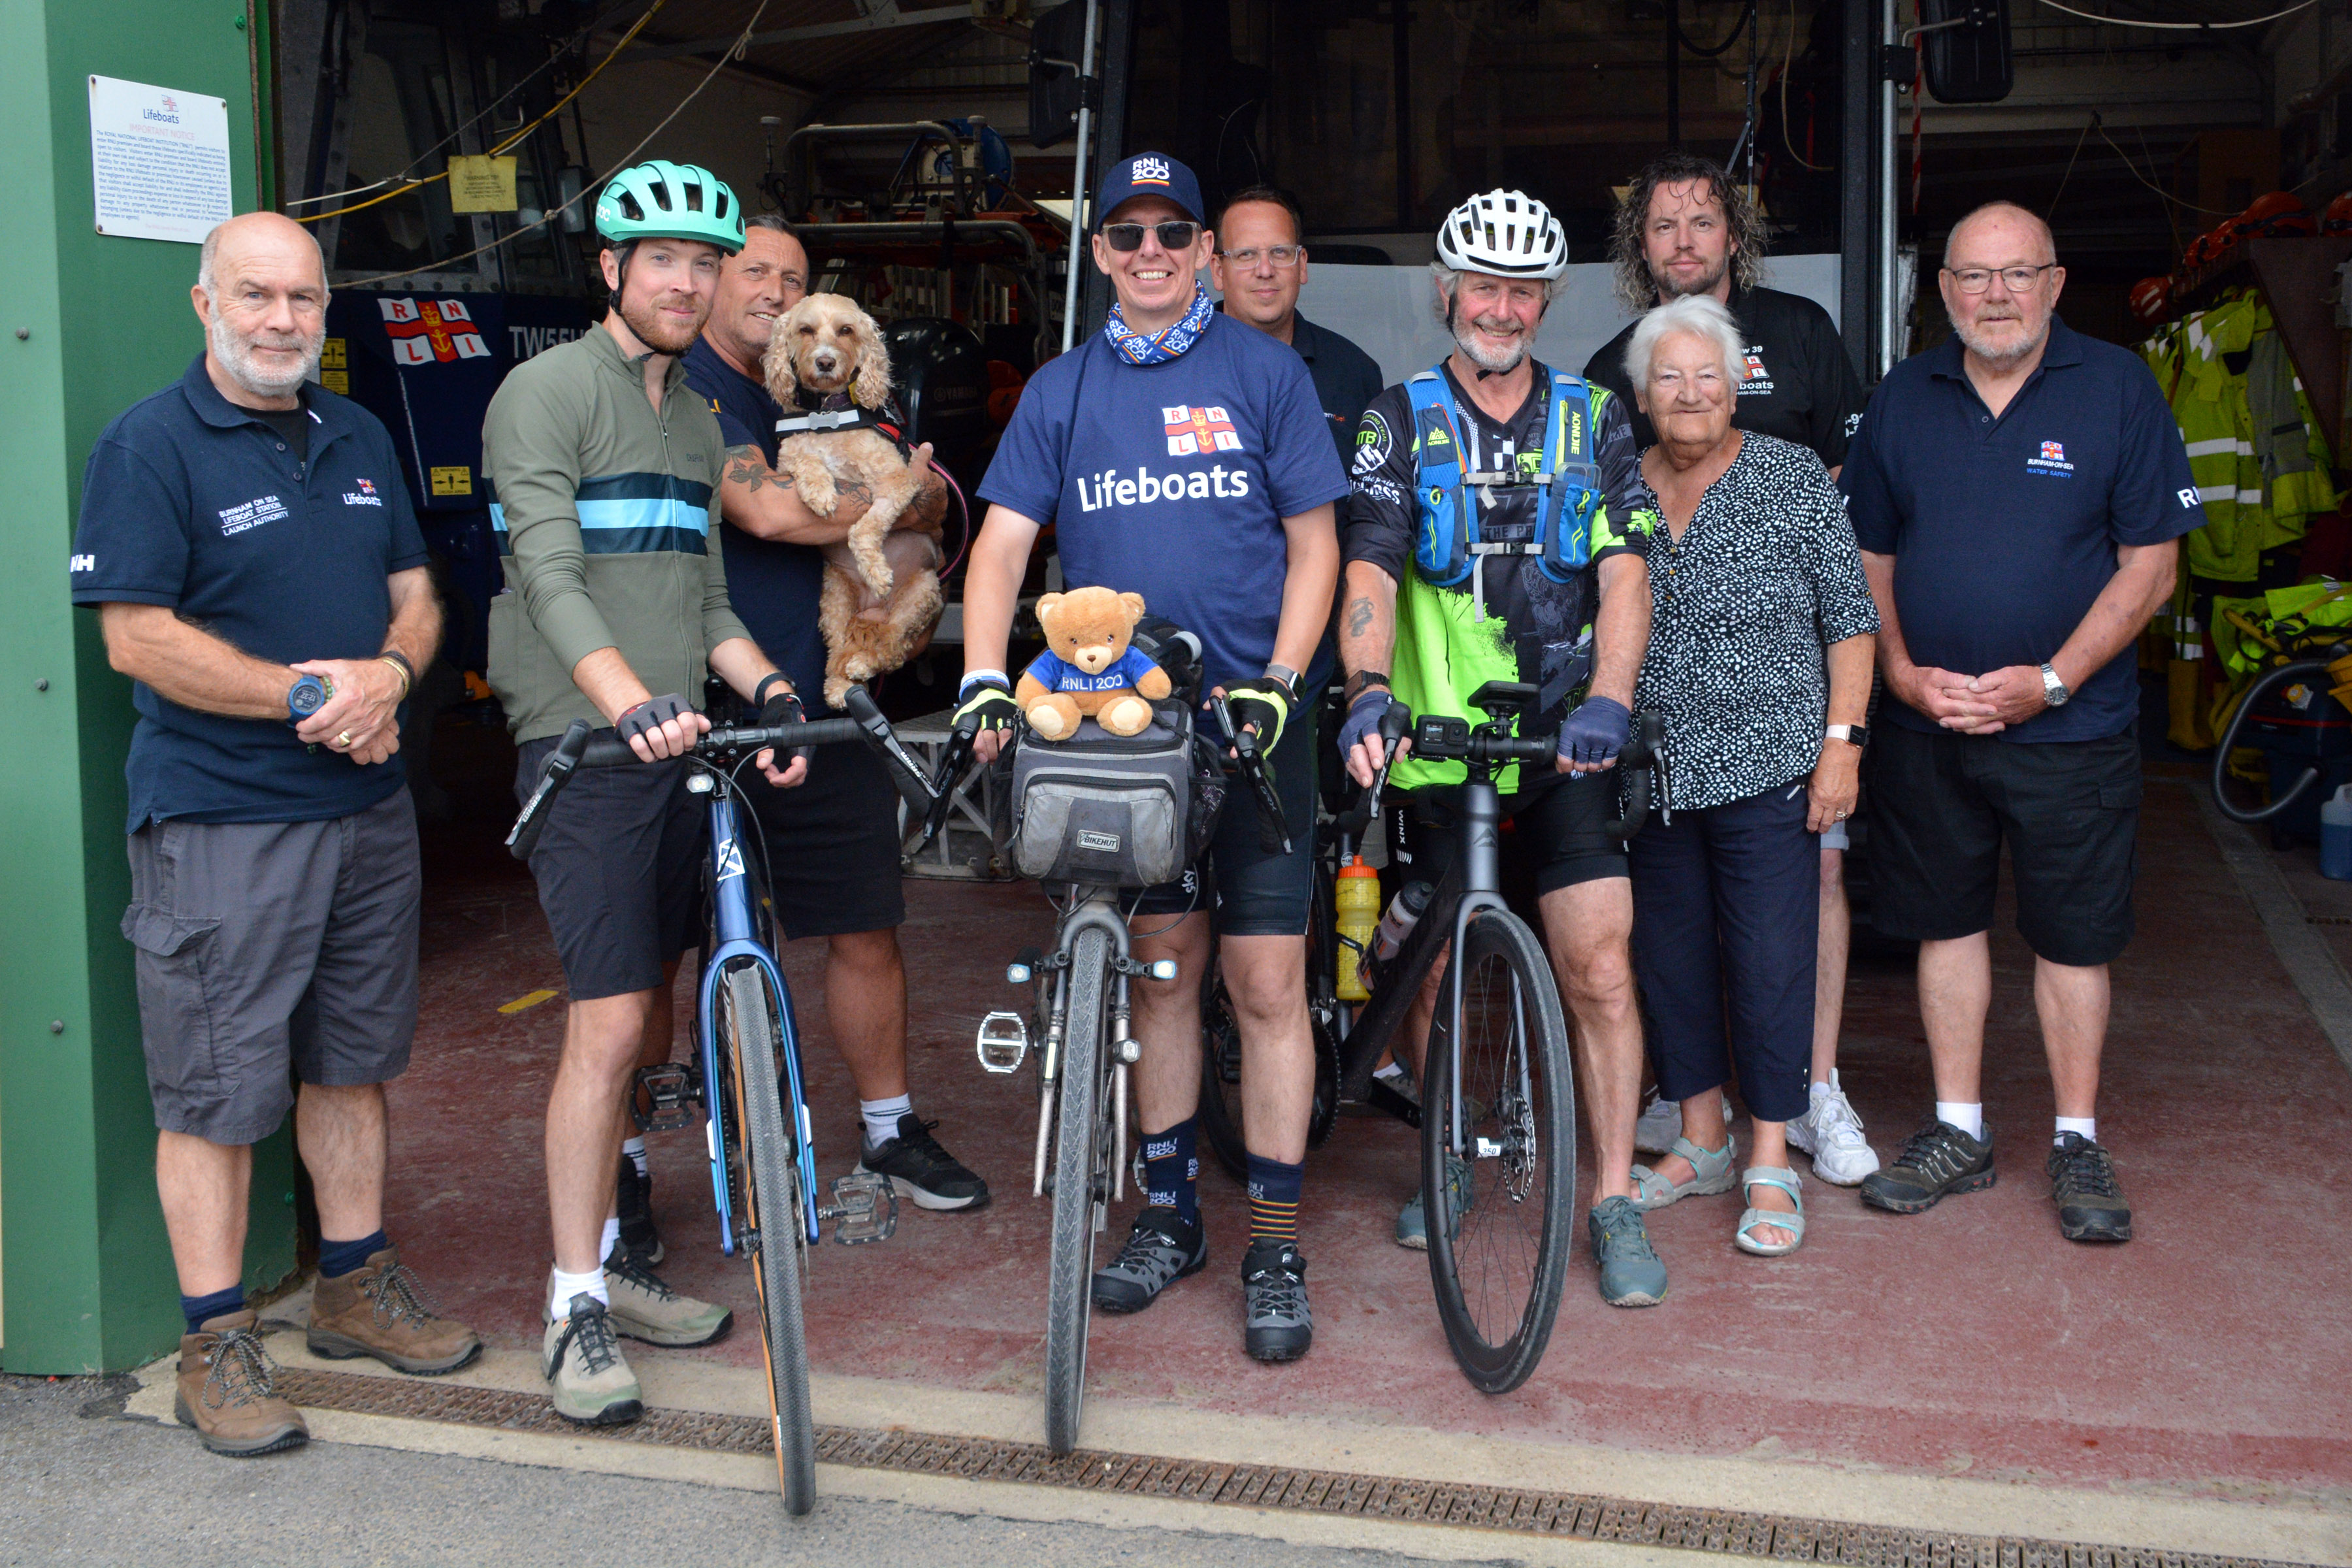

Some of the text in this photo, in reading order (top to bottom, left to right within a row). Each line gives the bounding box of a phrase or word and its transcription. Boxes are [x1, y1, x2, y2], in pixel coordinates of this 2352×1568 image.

[143, 108, 179, 124] Lifeboats
[131, 123, 194, 140] IMPORTANT NOTICE
[1132, 157, 1169, 171] RNLI
[1132, 167, 1169, 180] 200
[1172, 329, 1194, 344] RNLI
[1132, 336, 1153, 355] RNLI
[1739, 381, 1774, 389] boats
[945, 387, 977, 400] YAMAHA
[1571, 411, 1581, 455] AONIJIE
[2027, 459, 2074, 470] BURNHAM-ON-SEA
[1077, 465, 1249, 512] Lifeboats
[219, 495, 280, 518] BURNHAM ON SEA
[342, 493, 382, 507] Lifeboats
[222, 502, 281, 525] LIFEBOAT STATION
[222, 510, 289, 536] LAUNCH AUTHORITY
[1484, 527, 1509, 538] THE
[1062, 676, 1092, 691] RNLI
[523, 793, 542, 823] SRAM
[1084, 836, 1116, 847] BIKEHUT
[1147, 1137, 1178, 1151] RNLI
[1147, 1146, 1177, 1158] 200
